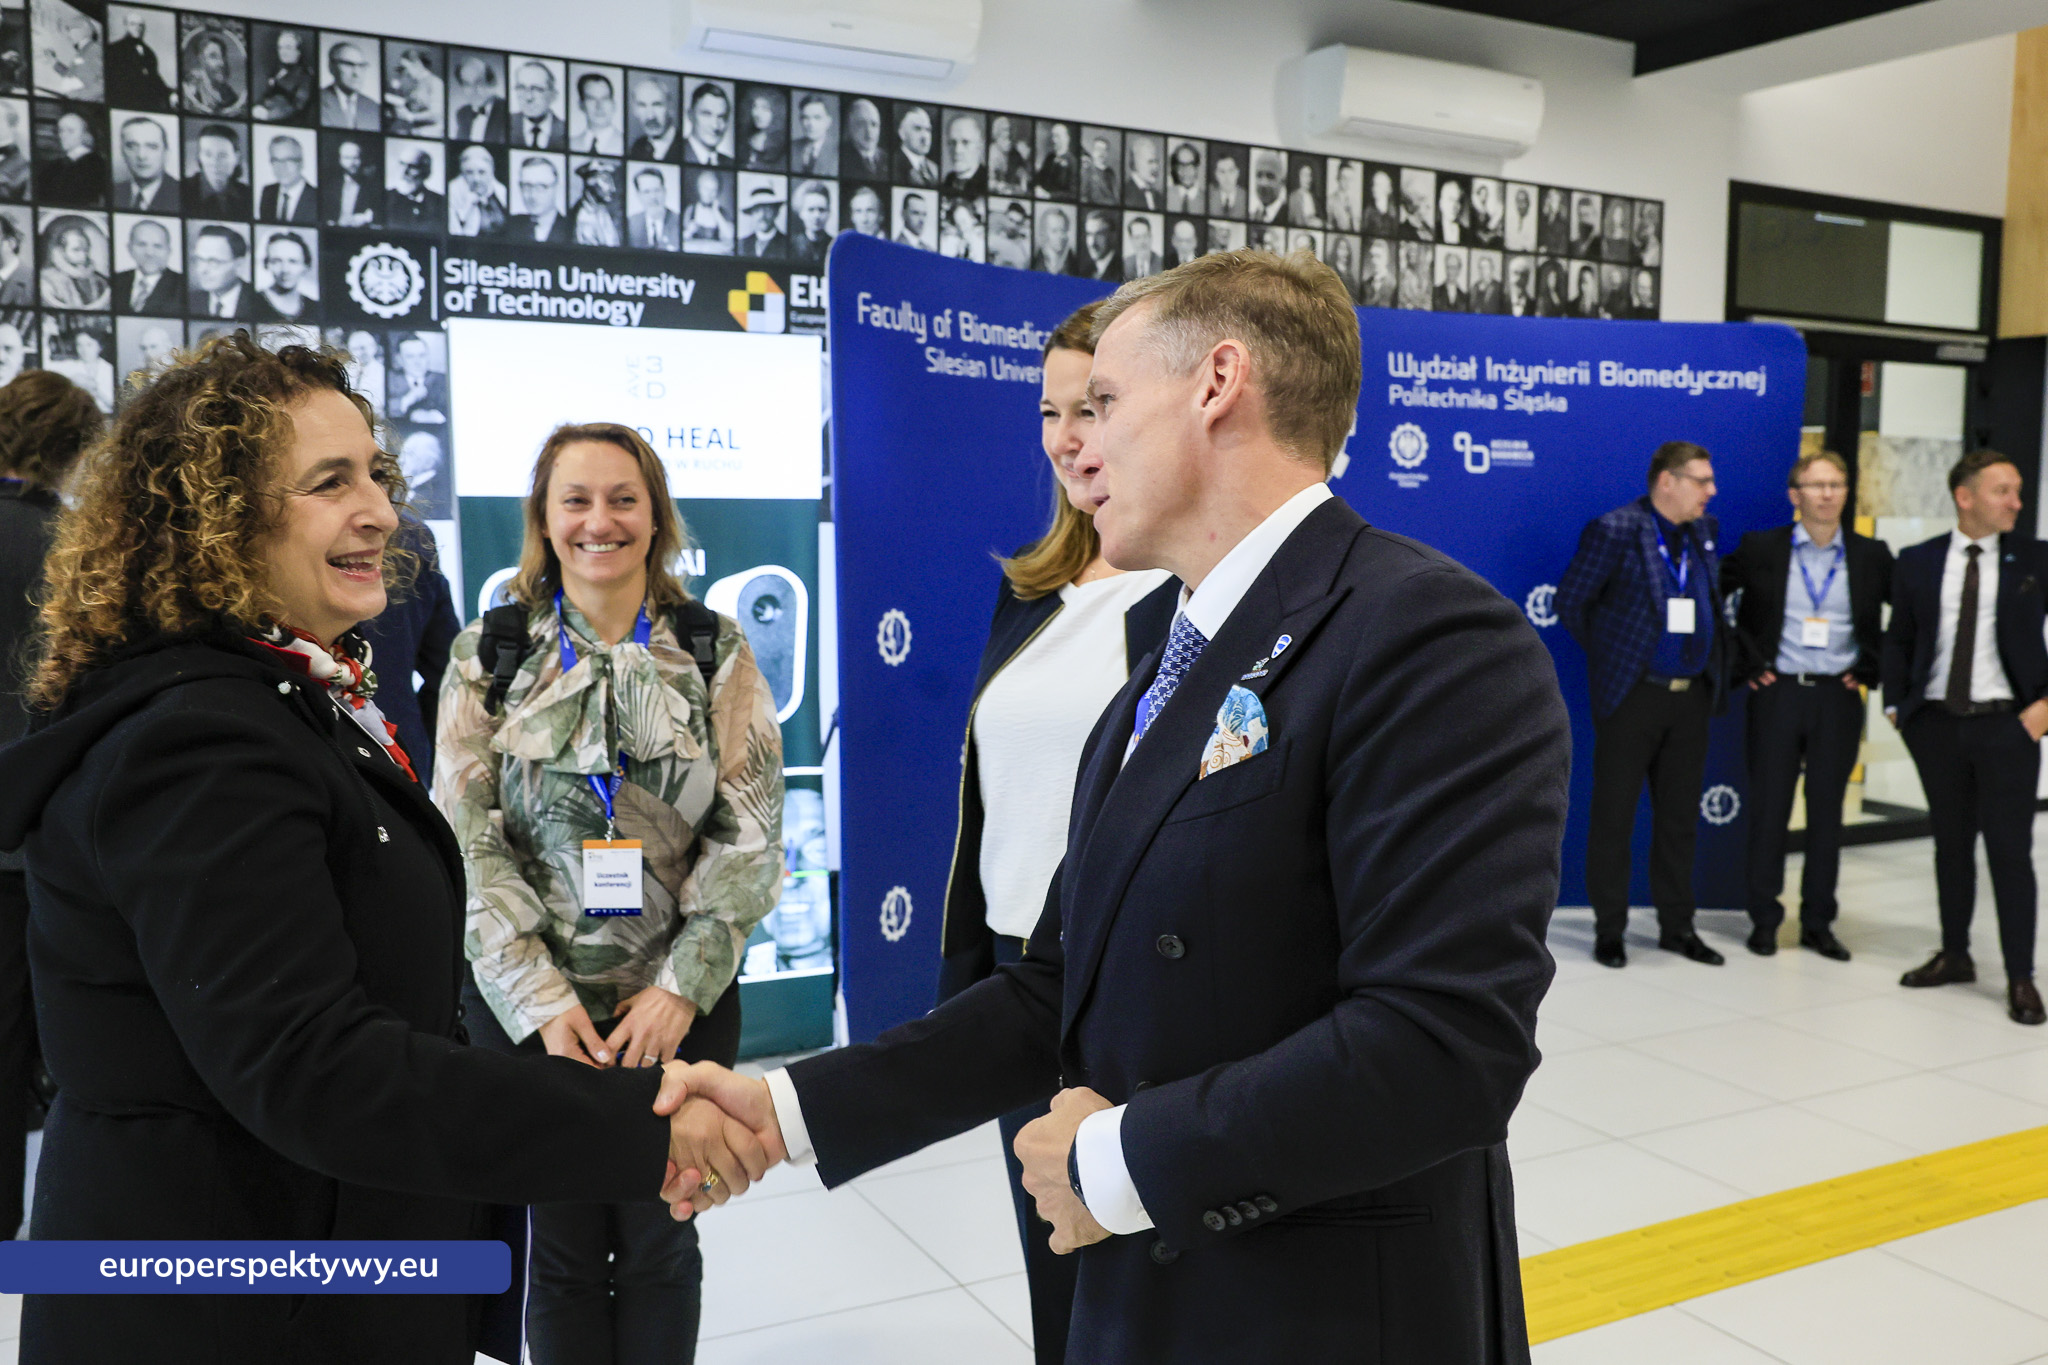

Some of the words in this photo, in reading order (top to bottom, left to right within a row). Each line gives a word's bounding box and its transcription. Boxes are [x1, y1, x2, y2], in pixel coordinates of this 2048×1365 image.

[443, 257, 552, 290] Silesian
[558, 265, 696, 305] University
[790, 273, 830, 309] EH
[443, 285, 478, 313] of
[481, 287, 645, 327] Technology
[858, 291, 927, 344] Faculty
[933, 308, 952, 339] of
[959, 310, 1057, 351] Biomedica
[925, 346, 987, 379] Silesian
[991, 355, 1044, 384] Univer
[1388, 351, 1478, 386] Wydział
[1485, 356, 1591, 391] Inżynierii
[1599, 360, 1767, 397] Biomedycznej
[1388, 384, 1498, 410] Politechnika
[1503, 385, 1569, 416] Śląska
[667, 427, 741, 450] HEAL
[672, 548, 706, 576] AI
